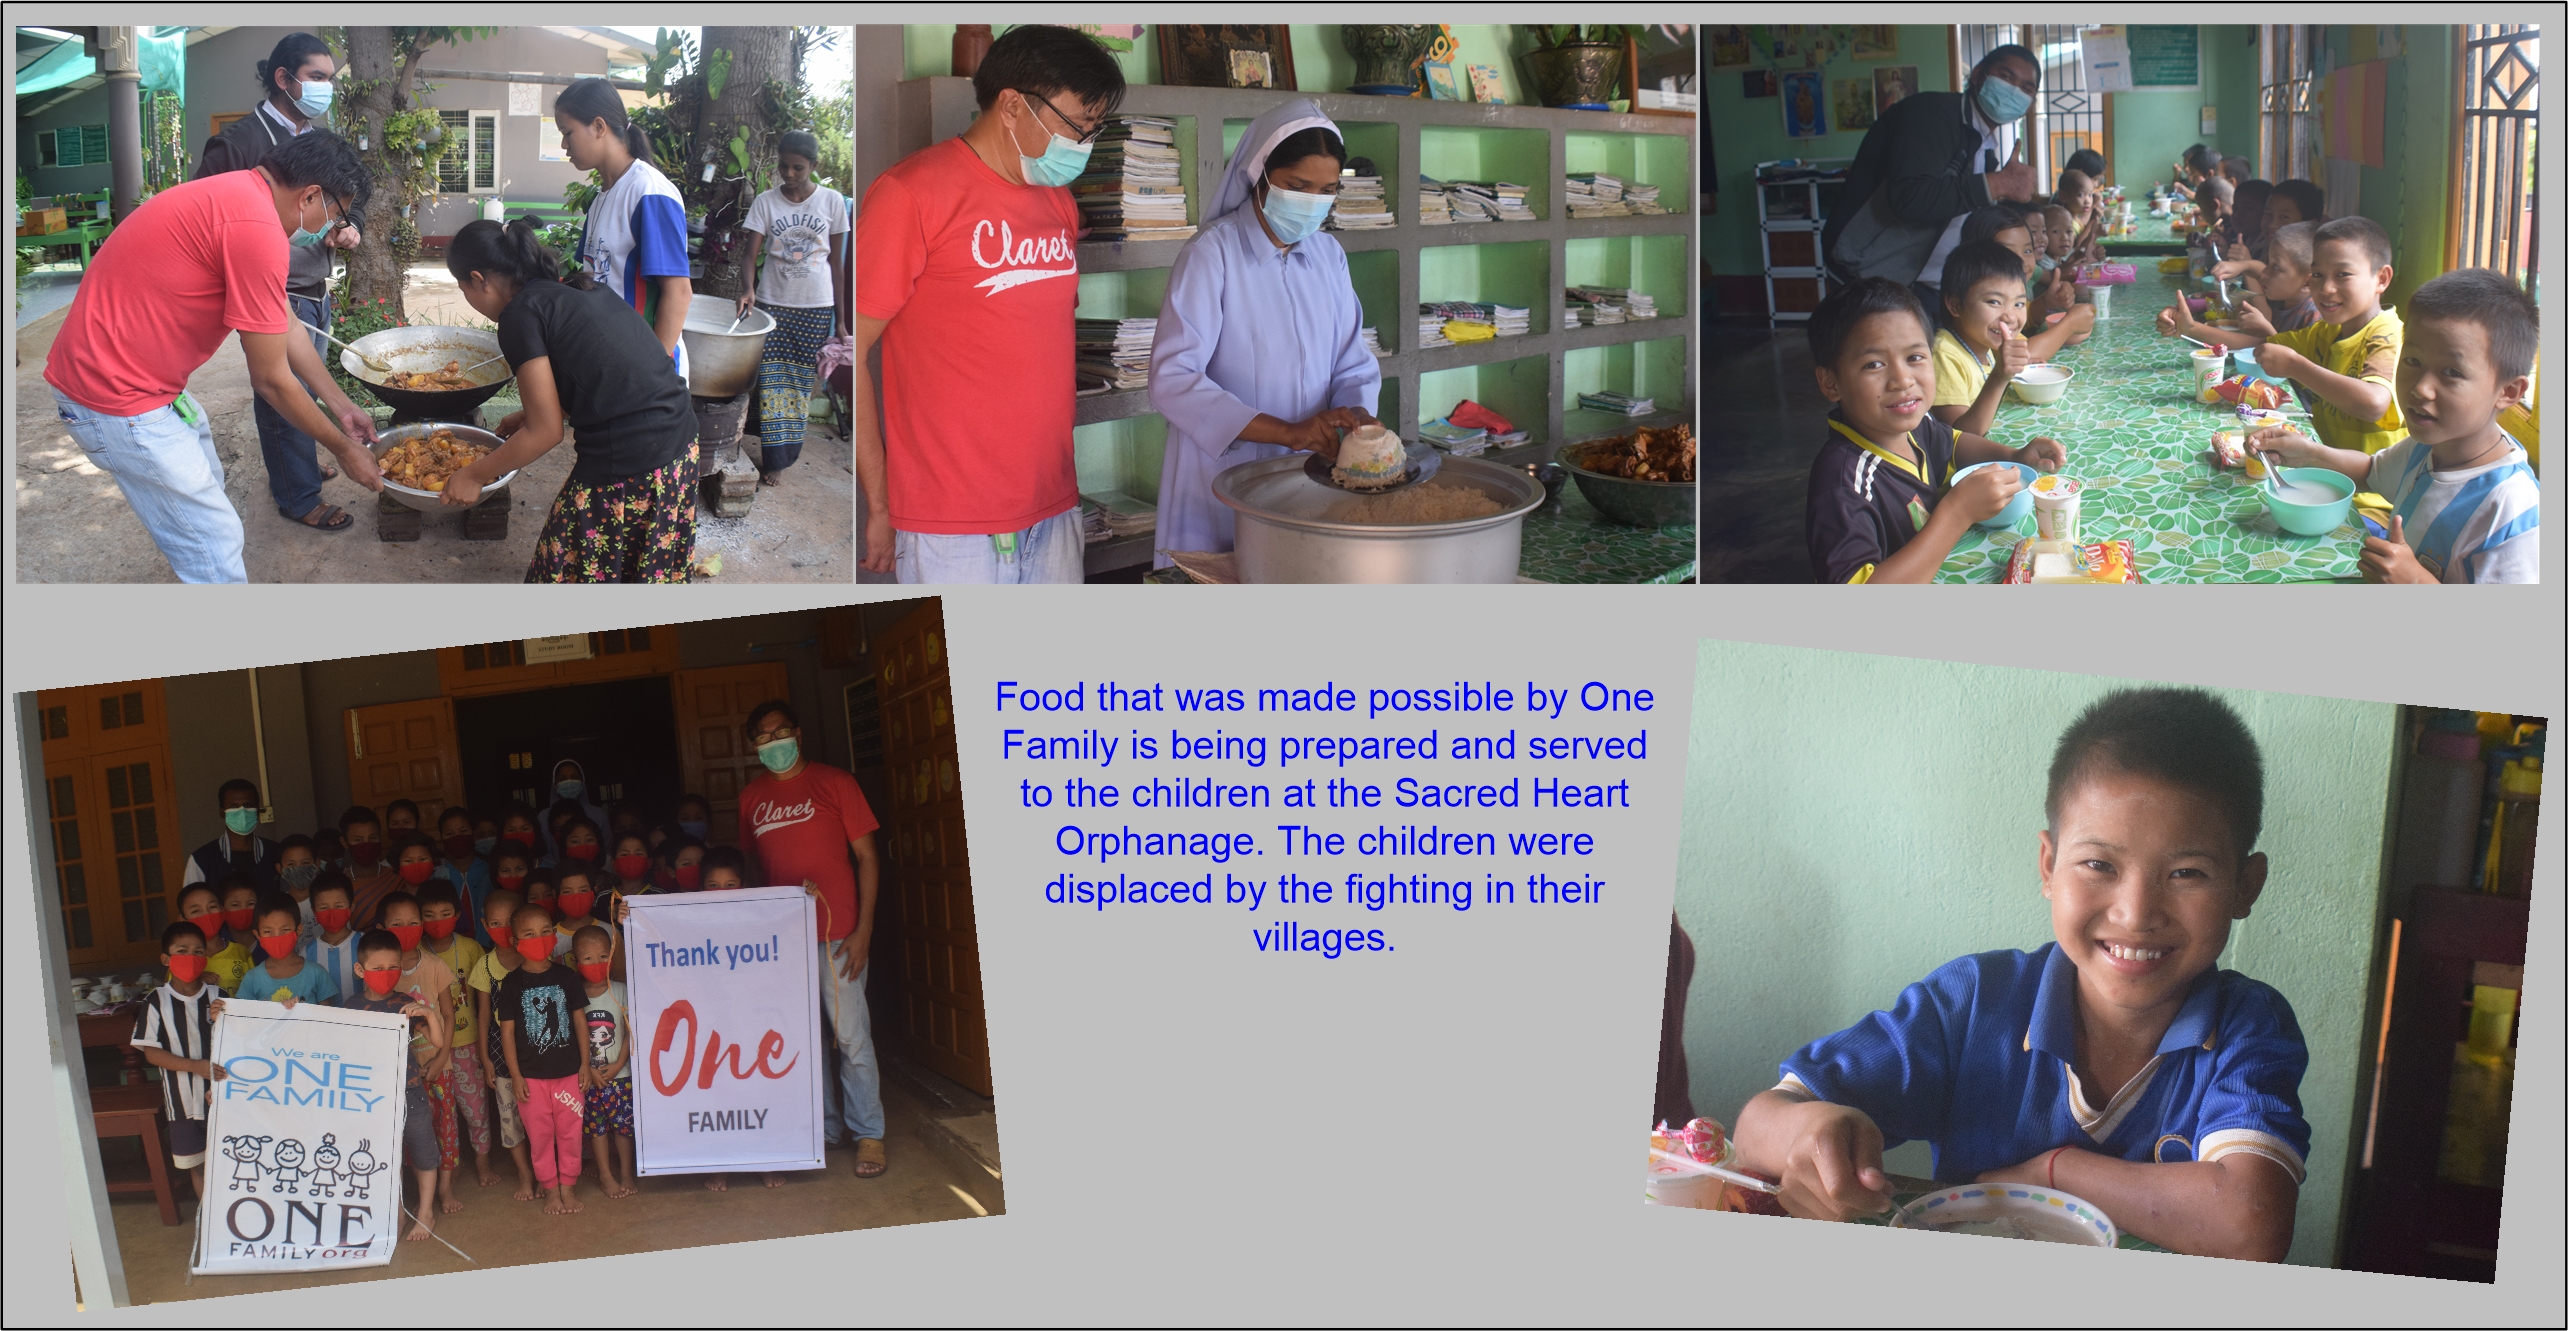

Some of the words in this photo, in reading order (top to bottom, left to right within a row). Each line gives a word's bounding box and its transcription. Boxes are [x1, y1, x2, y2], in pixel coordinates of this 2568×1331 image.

[771, 213, 826, 237] GOLDFISH
[971, 219, 1073, 269] Claret
[753, 798, 812, 826] Claret
[645, 938, 720, 968] Thank
[725, 934, 779, 970] you!
[271, 1047, 305, 1058] We
[310, 1051, 341, 1061] are
[649, 999, 800, 1097] One
[223, 1055, 373, 1092] ONE
[225, 1080, 385, 1113] FAMILY
[688, 1108, 769, 1133] FAMILY
[226, 1196, 376, 1249] ONE
[229, 1242, 317, 1260] FAMILY
